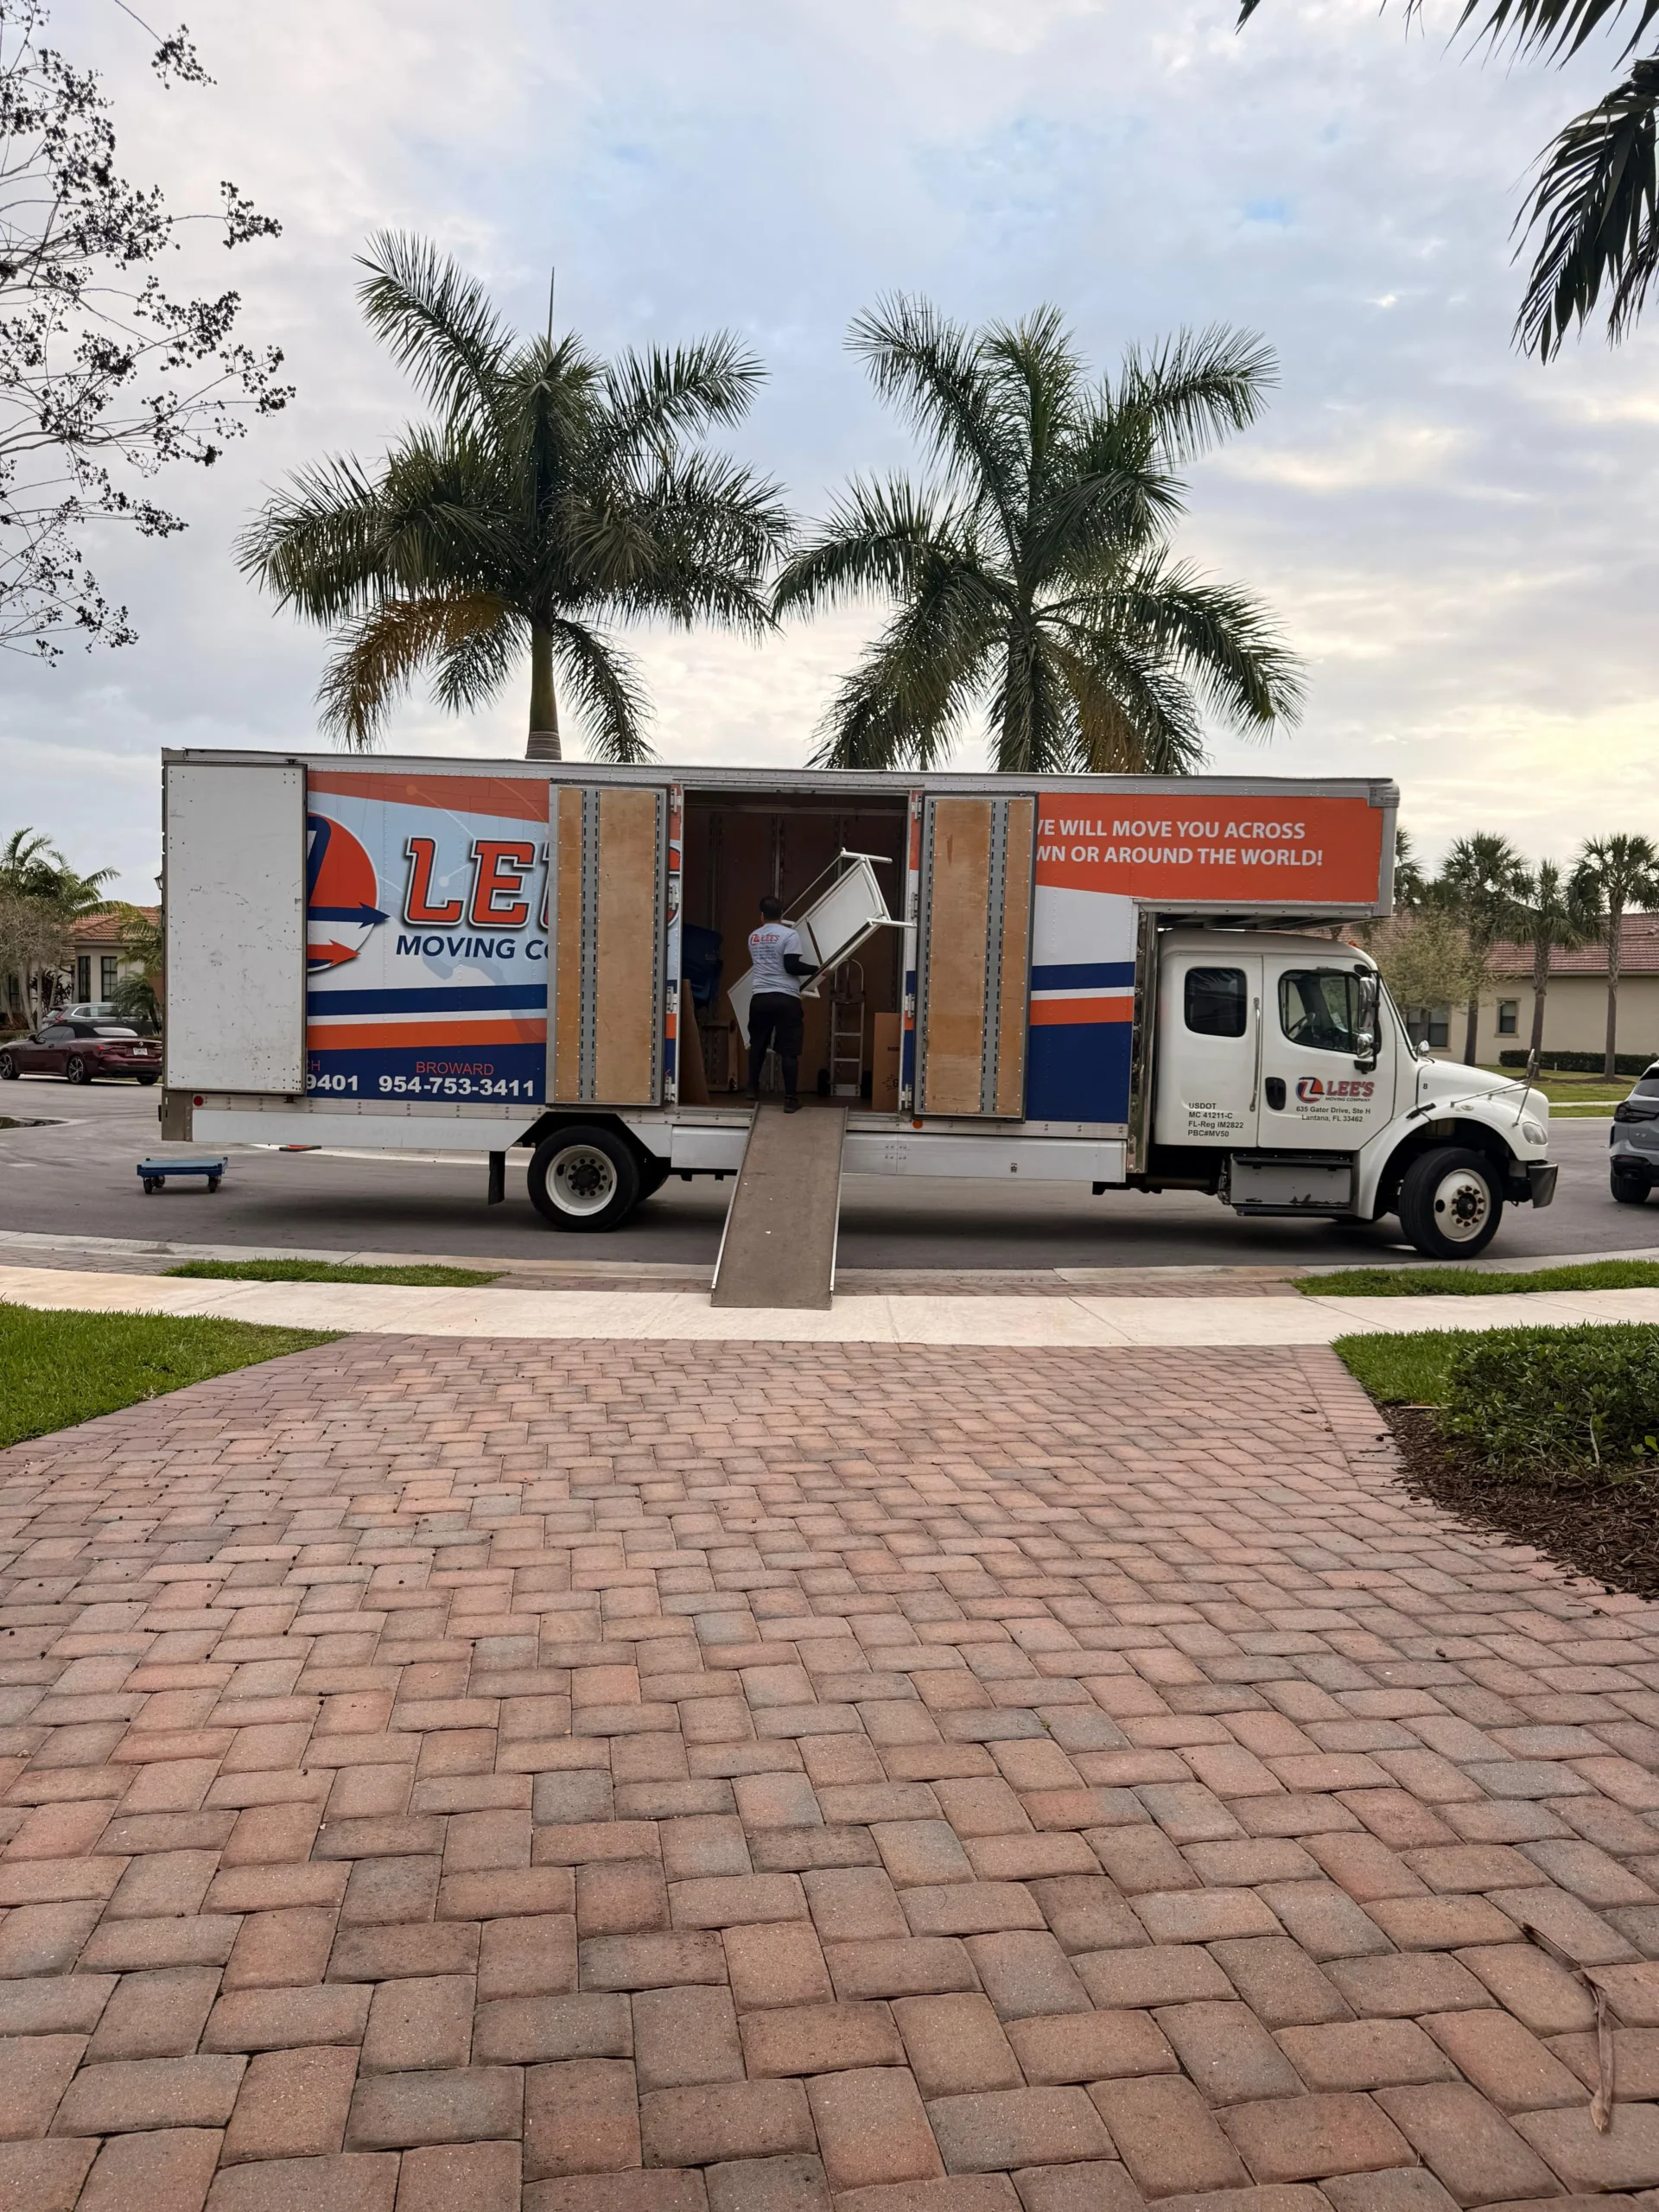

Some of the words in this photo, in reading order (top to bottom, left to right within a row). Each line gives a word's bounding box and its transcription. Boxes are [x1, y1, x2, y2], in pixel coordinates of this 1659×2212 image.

[1059, 820, 1107, 836] WILL
[1113, 821, 1172, 837] MOVE
[1177, 822, 1219, 838] YOU
[1224, 822, 1306, 840] ACROSS
[1071, 846, 1099, 862] OR
[1104, 846, 1193, 864] AROUND
[1198, 848, 1236, 865] THE
[1241, 849, 1323, 866] WORLD!
[403, 836, 549, 931] LE
[397, 936, 516, 959] MOVING
[525, 938, 549, 960] C
[416, 1061, 494, 1076] BROWARD
[378, 1076, 534, 1096] 954-753-3411
[1326, 1080, 1376, 1097] LEE'S
